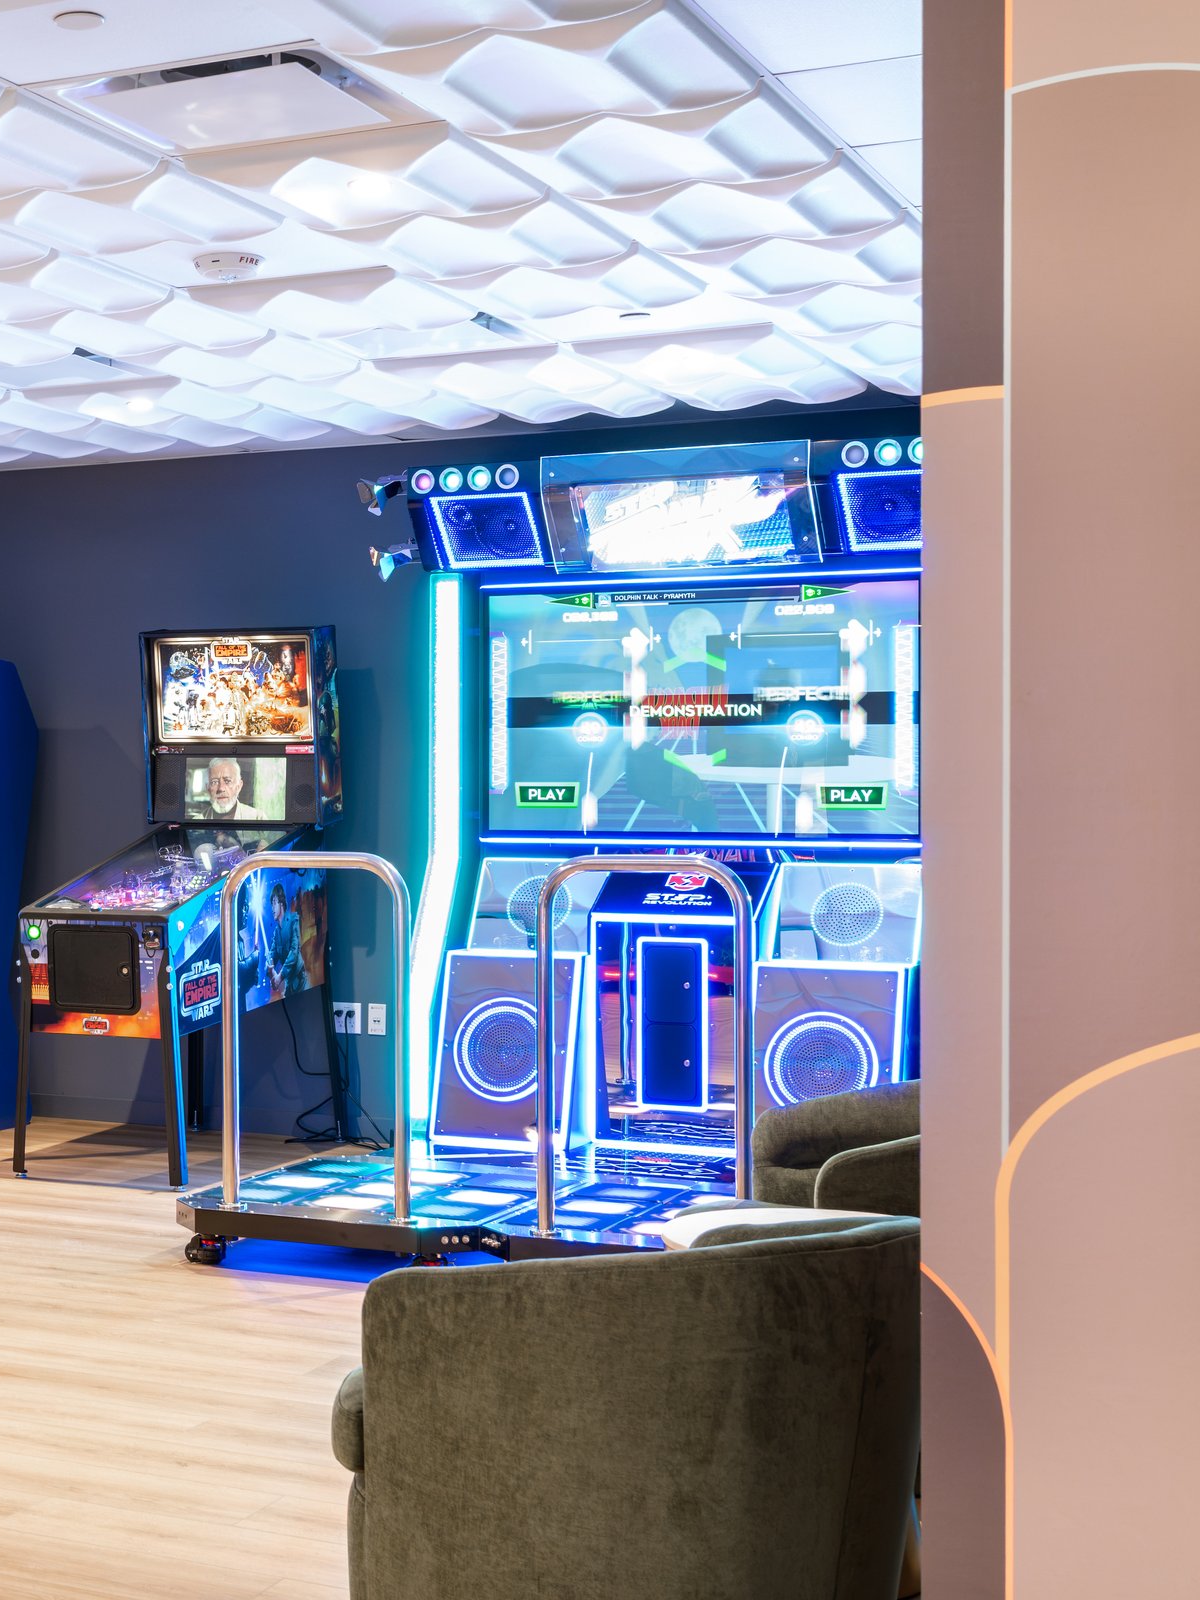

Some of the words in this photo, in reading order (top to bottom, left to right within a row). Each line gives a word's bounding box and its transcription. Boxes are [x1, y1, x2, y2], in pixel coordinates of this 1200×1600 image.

[239, 256, 259, 266] FIRE
[663, 592, 696, 600] PYRAMYTH
[629, 704, 763, 718] DEMONSTRATION
[528, 788, 566, 801] PLAY
[830, 789, 873, 802] PLAY
[645, 893, 706, 901] STEP
[191, 959, 210, 975] STAR
[185, 980, 197, 991] FALL
[198, 977, 206, 987] OF
[207, 974, 217, 984] THE
[185, 982, 217, 1006] EMPIRE
[191, 1004, 214, 1021] WARS
